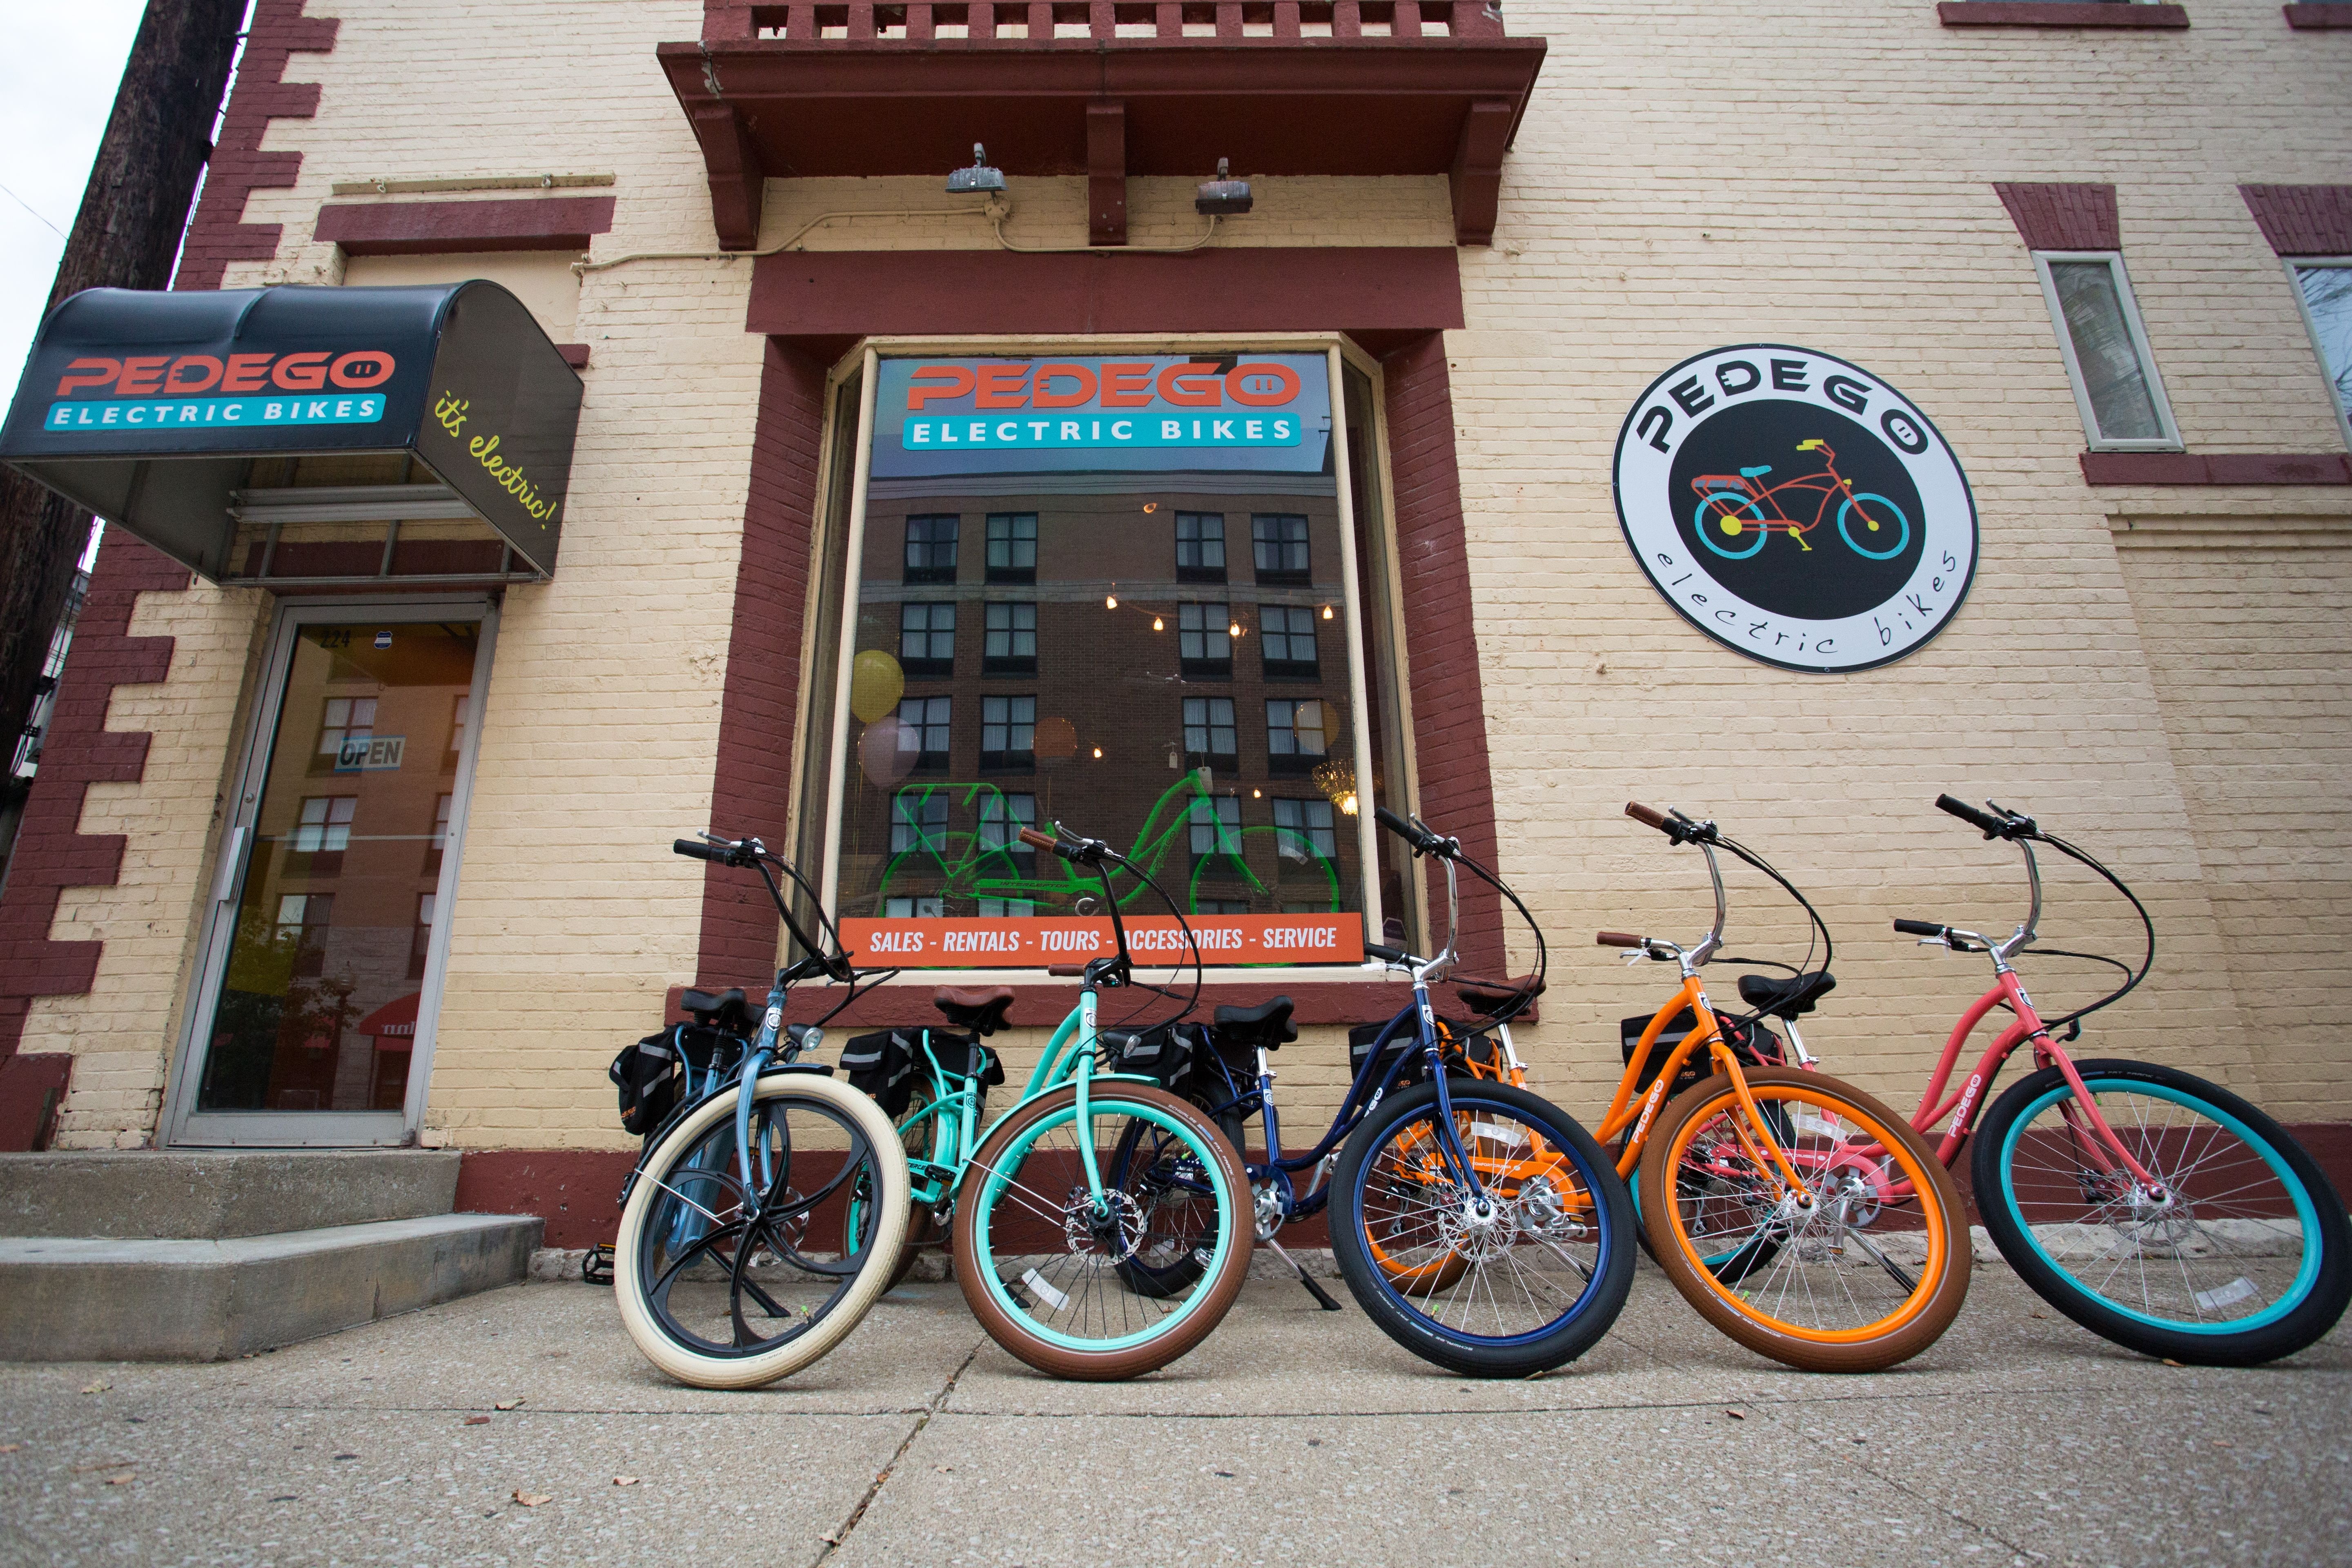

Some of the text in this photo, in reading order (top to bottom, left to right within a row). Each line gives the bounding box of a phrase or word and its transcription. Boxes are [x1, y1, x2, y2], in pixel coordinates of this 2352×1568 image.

[56, 351, 395, 396] PEDEGO
[908, 363, 1301, 410] PEDEGO
[53, 399, 375, 425] ELECTRIC BIKES
[1636, 359, 1929, 455] PEDEGO
[913, 419, 1291, 443] ELECTRIC BIKES
[434, 390, 557, 530] it's electric!
[1657, 550, 1956, 653] electric bikes
[321, 629, 351, 648] 224
[340, 741, 401, 765] OPEN
[869, 931, 924, 952] SALES
[944, 931, 1020, 951] RENTALS
[1040, 930, 1100, 951] TOURS
[1263, 927, 1337, 948] SERVICE
[1632, 1079, 1664, 1144] PEDEGO
[1948, 1074, 1981, 1137] PEDEGO
[1168, 1105, 1234, 1176] SCHWALBE FAT FRANK
